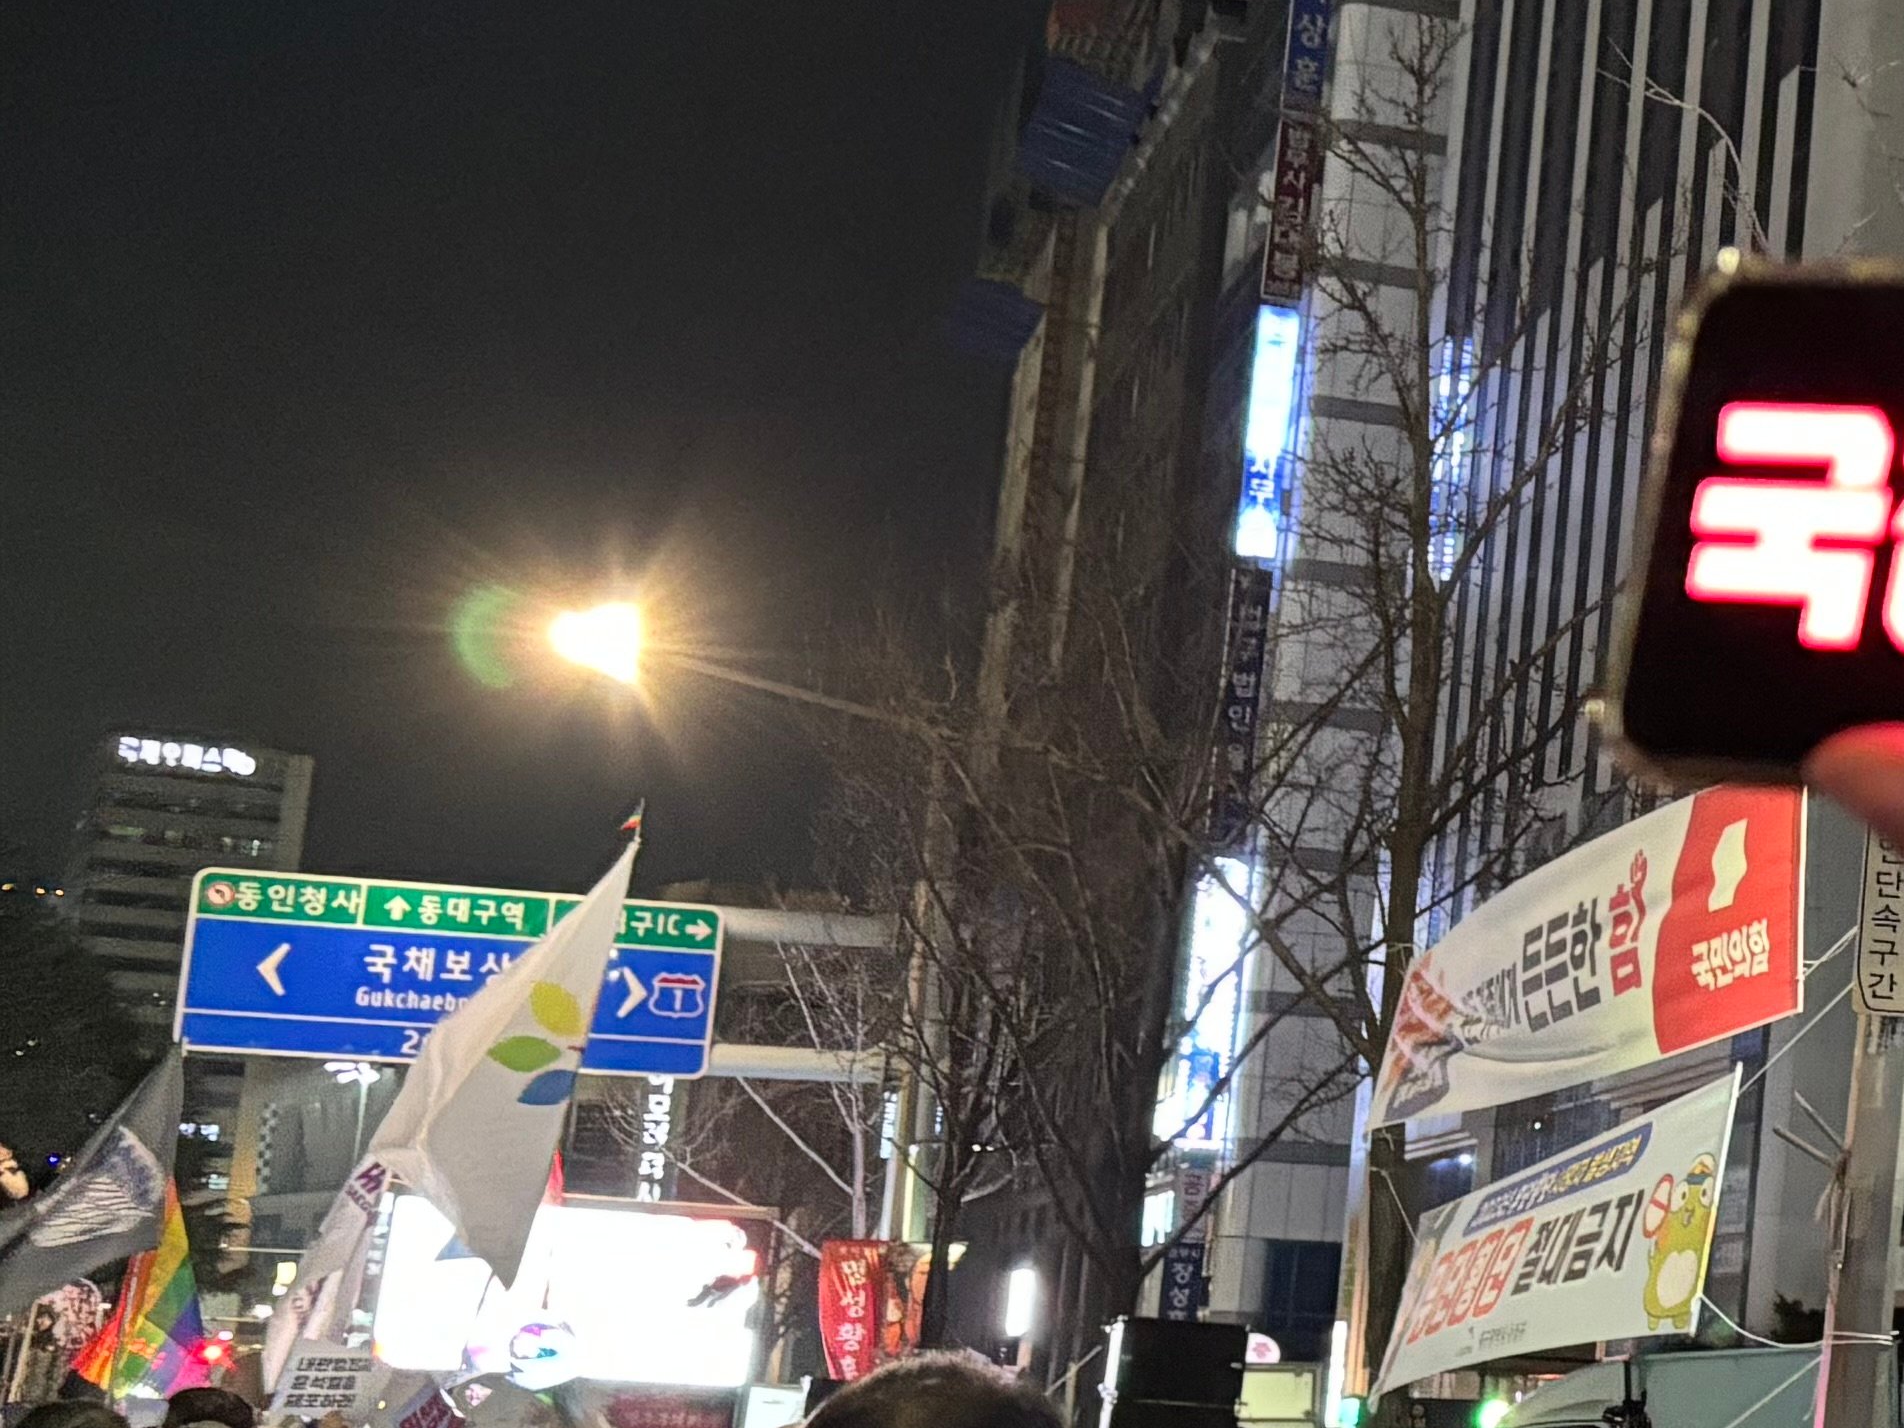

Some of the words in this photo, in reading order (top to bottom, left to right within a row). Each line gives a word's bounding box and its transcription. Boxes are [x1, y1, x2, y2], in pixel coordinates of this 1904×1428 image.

[235, 882, 362, 916] 동인청사
[418, 895, 526, 932] 동대구역
[1522, 897, 1601, 1033] 든든한
[1609, 849, 1648, 997] 힘
[1691, 918, 1771, 991] 국민의힘
[1510, 1189, 1645, 1296] 절대금지
